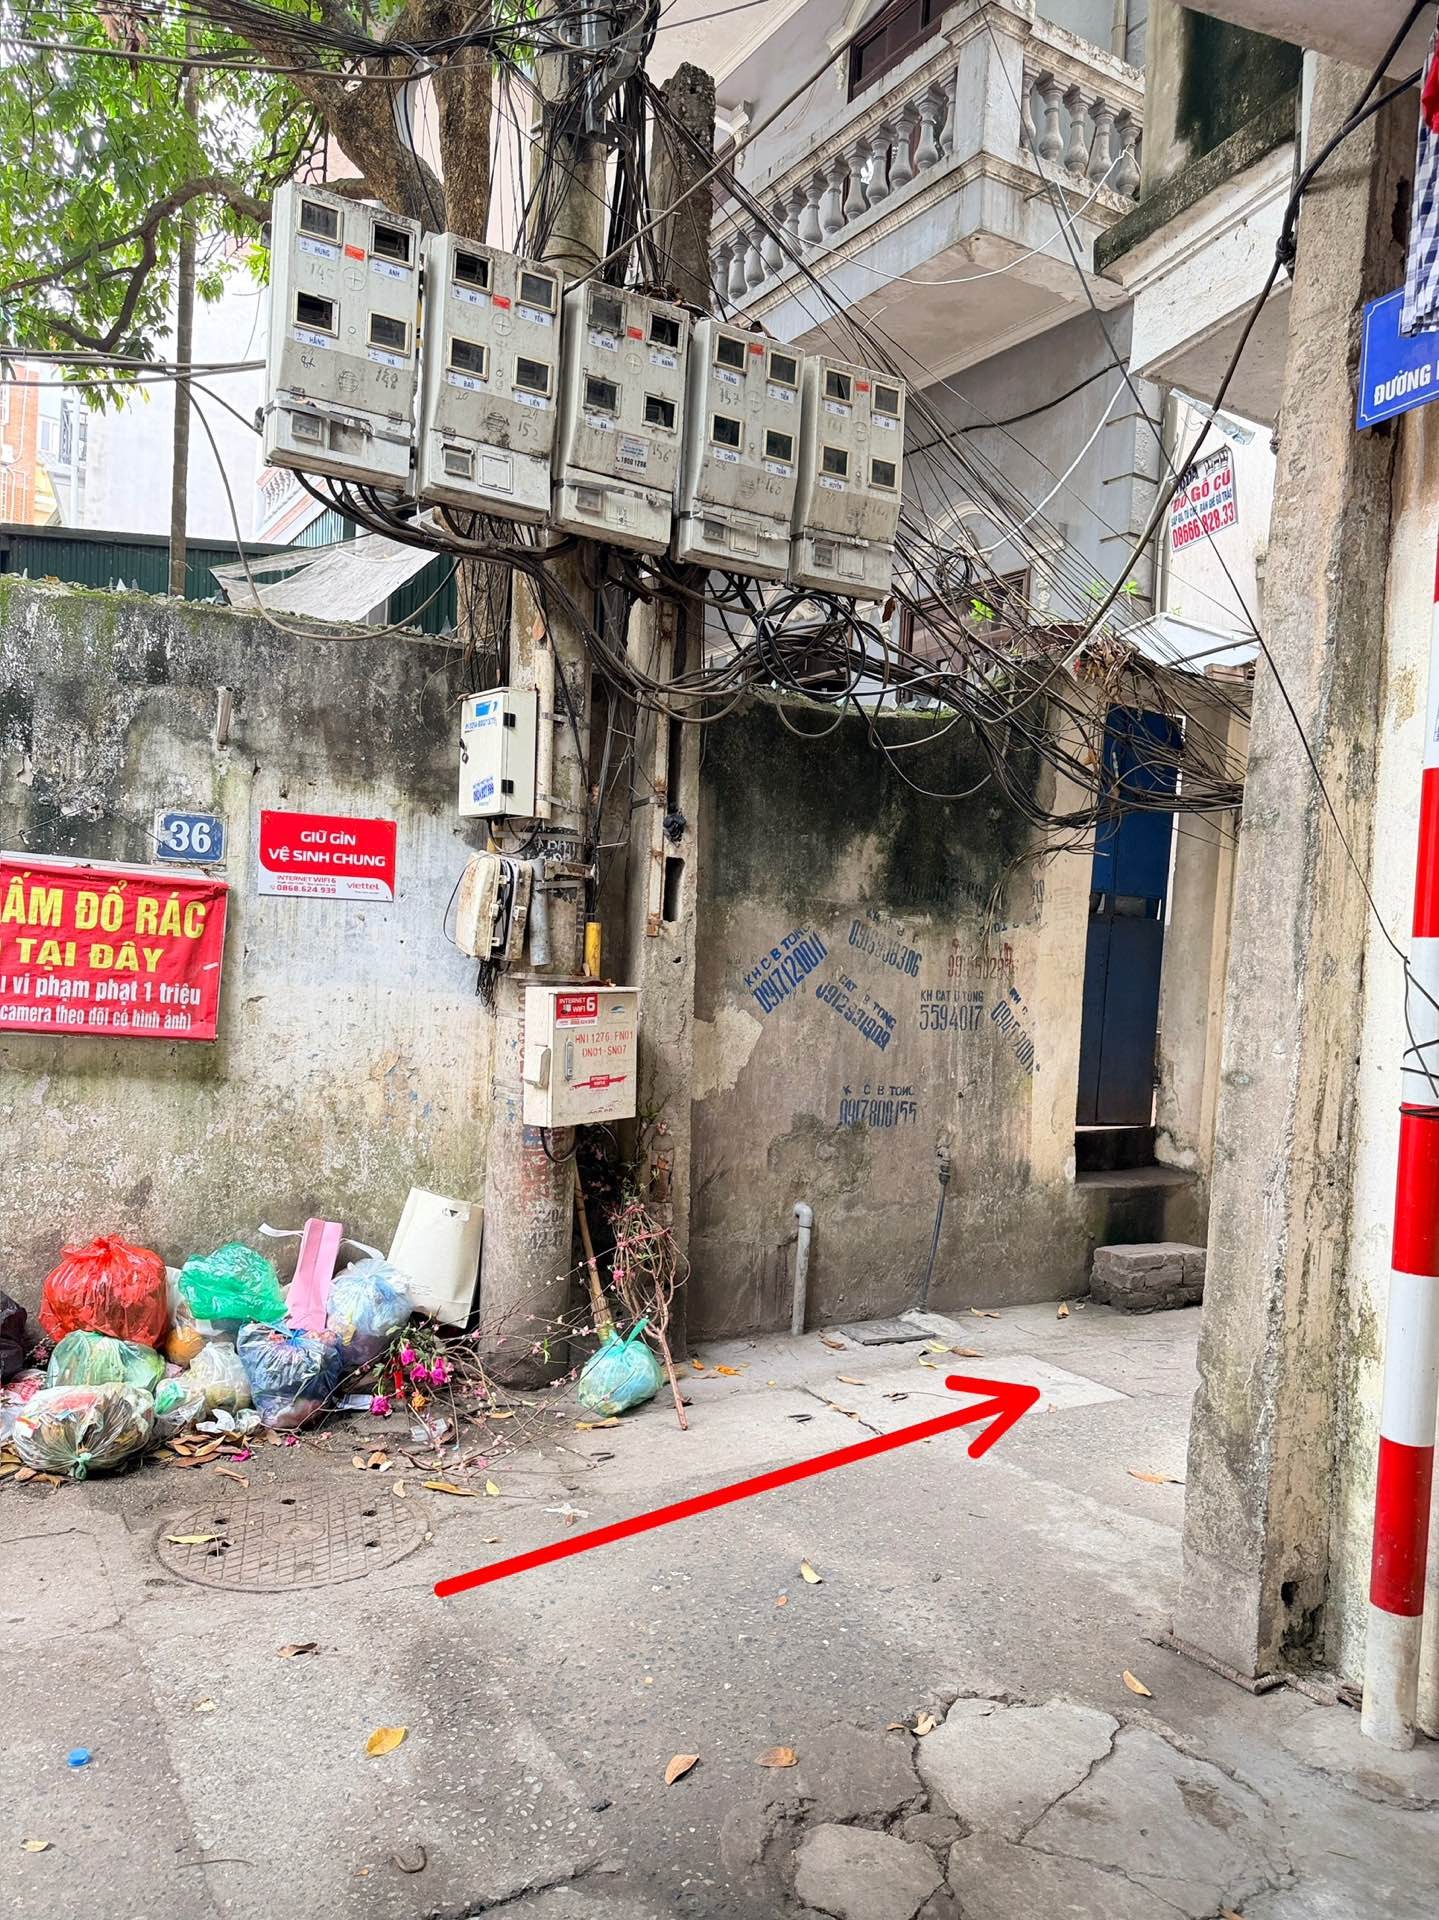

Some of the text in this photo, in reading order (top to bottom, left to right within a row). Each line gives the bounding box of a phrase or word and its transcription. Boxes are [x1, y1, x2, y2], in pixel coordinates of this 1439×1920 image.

[1374, 363, 1432, 406] ĐƯỜNG
[1172, 502, 1234, 548] 08666.828.33
[169, 820, 212, 853] 36
[301, 829, 356, 846] GIỮ GÌN
[268, 846, 386, 866] VỆ SINH CHUNG
[277, 874, 313, 883] INTERNET
[346, 881, 380, 891] viettel
[1, 871, 207, 938] ẤM ĐỔ RÁC
[15, 937, 164, 973] TẠI ĐÂY
[13, 972, 30, 994] vi
[35, 974, 90, 1002] phạm
[95, 978, 138, 1006] phạt
[144, 982, 152, 1002] 1
[160, 983, 200, 1009] triệu
[586, 997, 596, 1012] 6
[0, 1004, 52, 1022] camera
[55, 1004, 85, 1024] theo
[112, 1008, 129, 1027] có
[919, 1004, 984, 1032] 5594017
